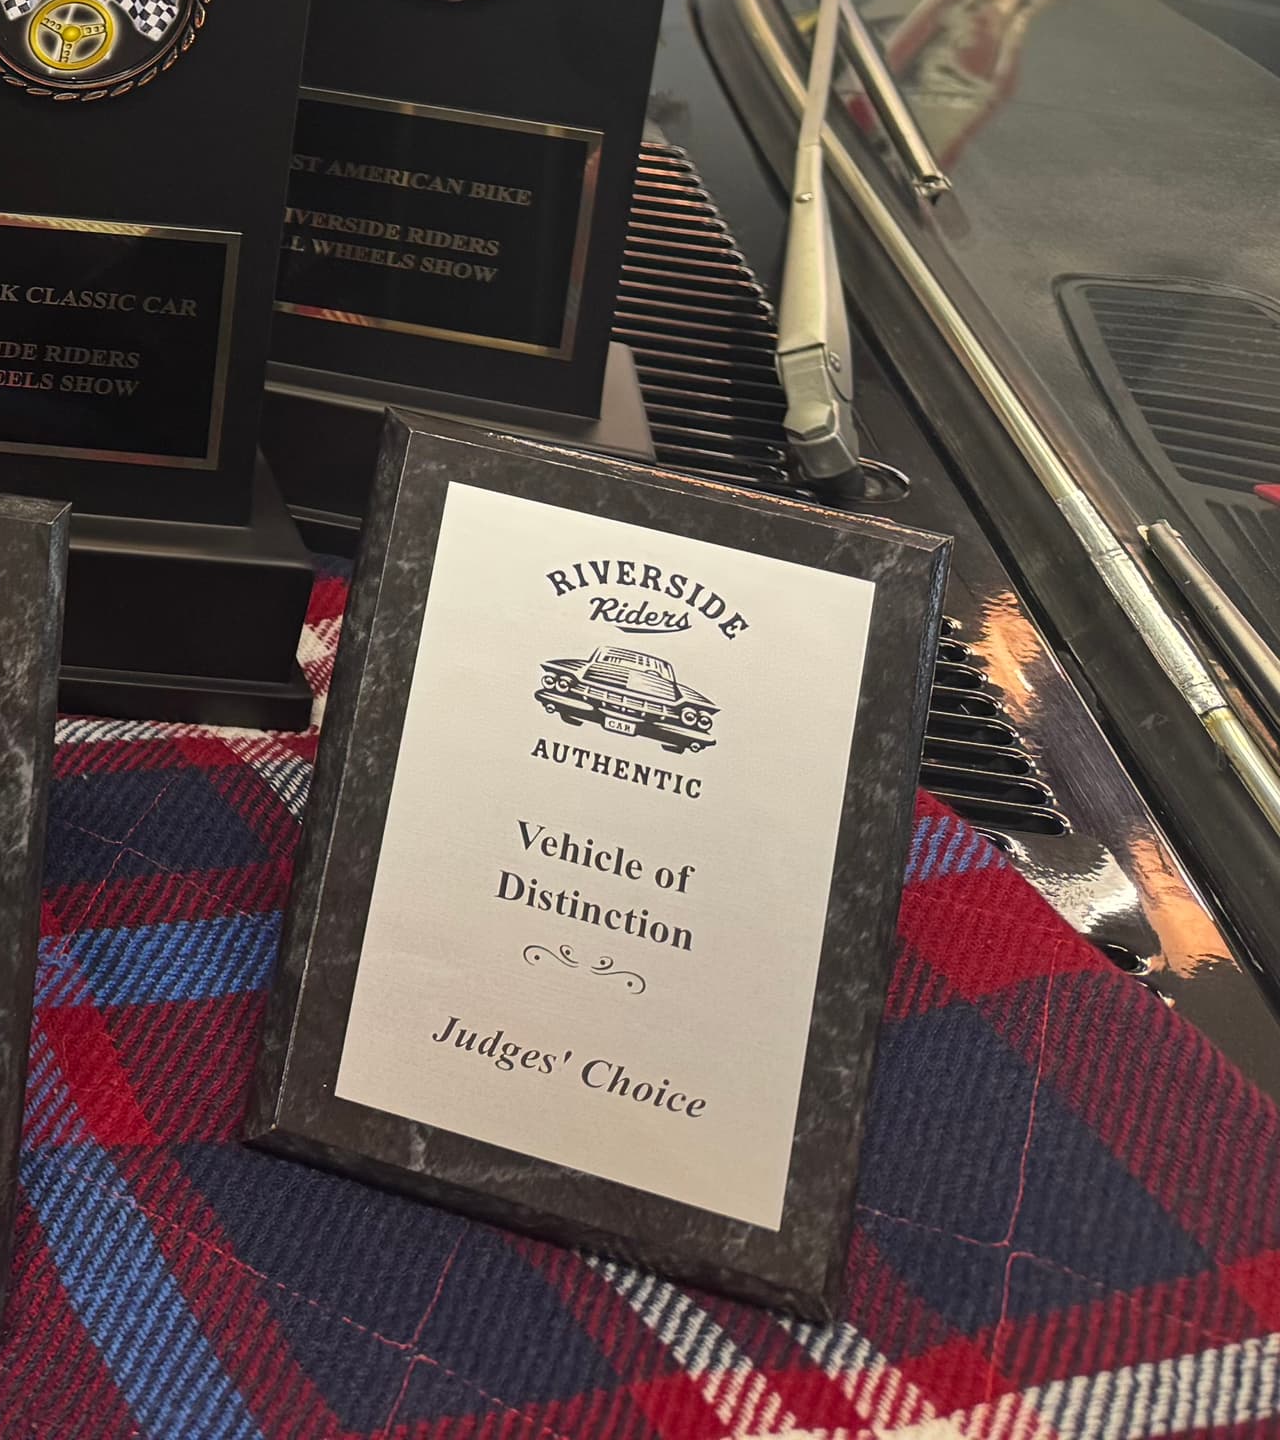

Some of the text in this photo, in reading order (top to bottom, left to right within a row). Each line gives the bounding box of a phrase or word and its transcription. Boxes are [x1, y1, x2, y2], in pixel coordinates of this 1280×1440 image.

[290, 154, 533, 206] ST AMERICAN BIKE
[283, 207, 500, 256] IVERSIDE RIDERS
[312, 238, 415, 270] WHEELS
[419, 257, 498, 282] SHOW
[25, 285, 136, 312] CLASSIC
[142, 295, 197, 316] CAR
[44, 344, 139, 368] RIDERS
[59, 375, 139, 397] SHOW
[546, 560, 750, 640] RIVERSIDE
[590, 597, 692, 634] Riders
[608, 720, 631, 733] CAR
[531, 738, 702, 799] AUTHENTIC
[516, 819, 696, 894] Vehicle of
[495, 870, 695, 951] Distinction
[432, 1015, 708, 1120] Judges' Choice
